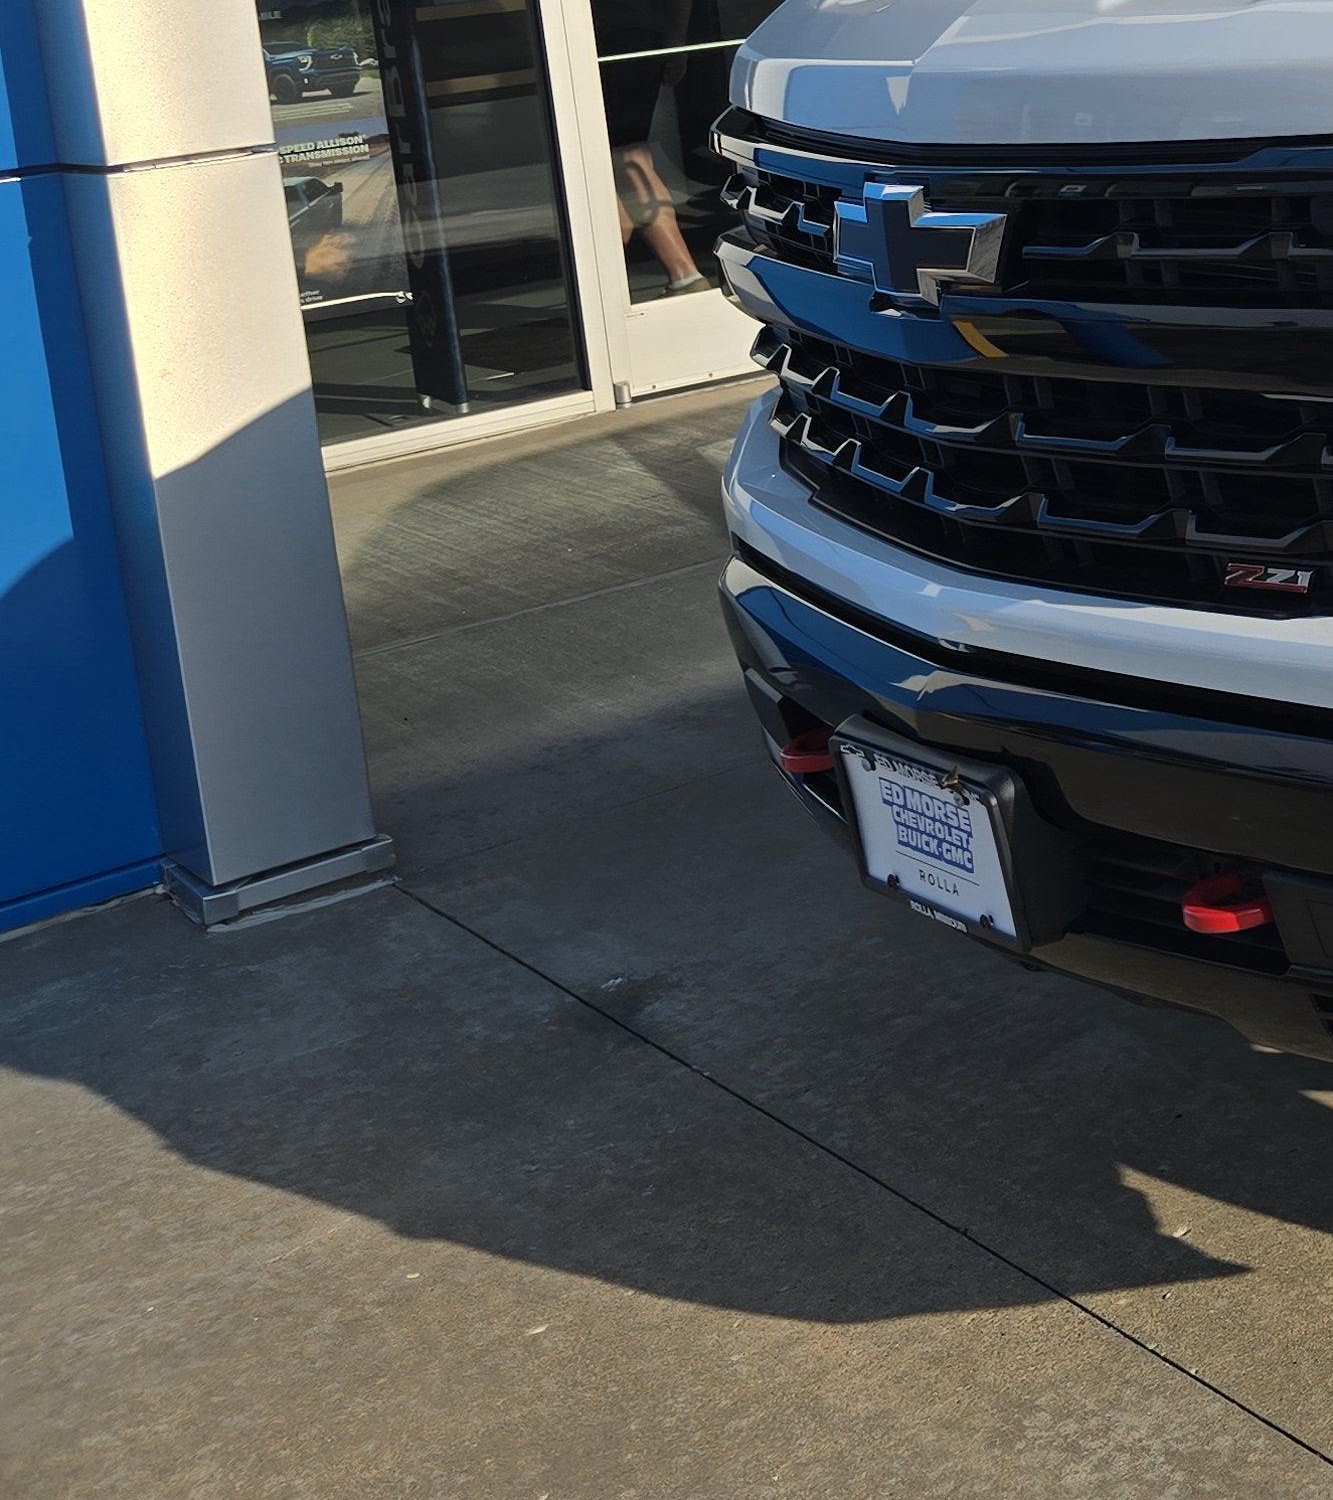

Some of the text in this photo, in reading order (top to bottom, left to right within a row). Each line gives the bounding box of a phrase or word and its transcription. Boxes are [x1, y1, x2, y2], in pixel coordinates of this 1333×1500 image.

[284, 143, 370, 163] TRANSMISSION
[1224, 563, 1313, 593] Z71
[880, 779, 972, 833] ED MORSE
[919, 869, 959, 896] ROLLA
